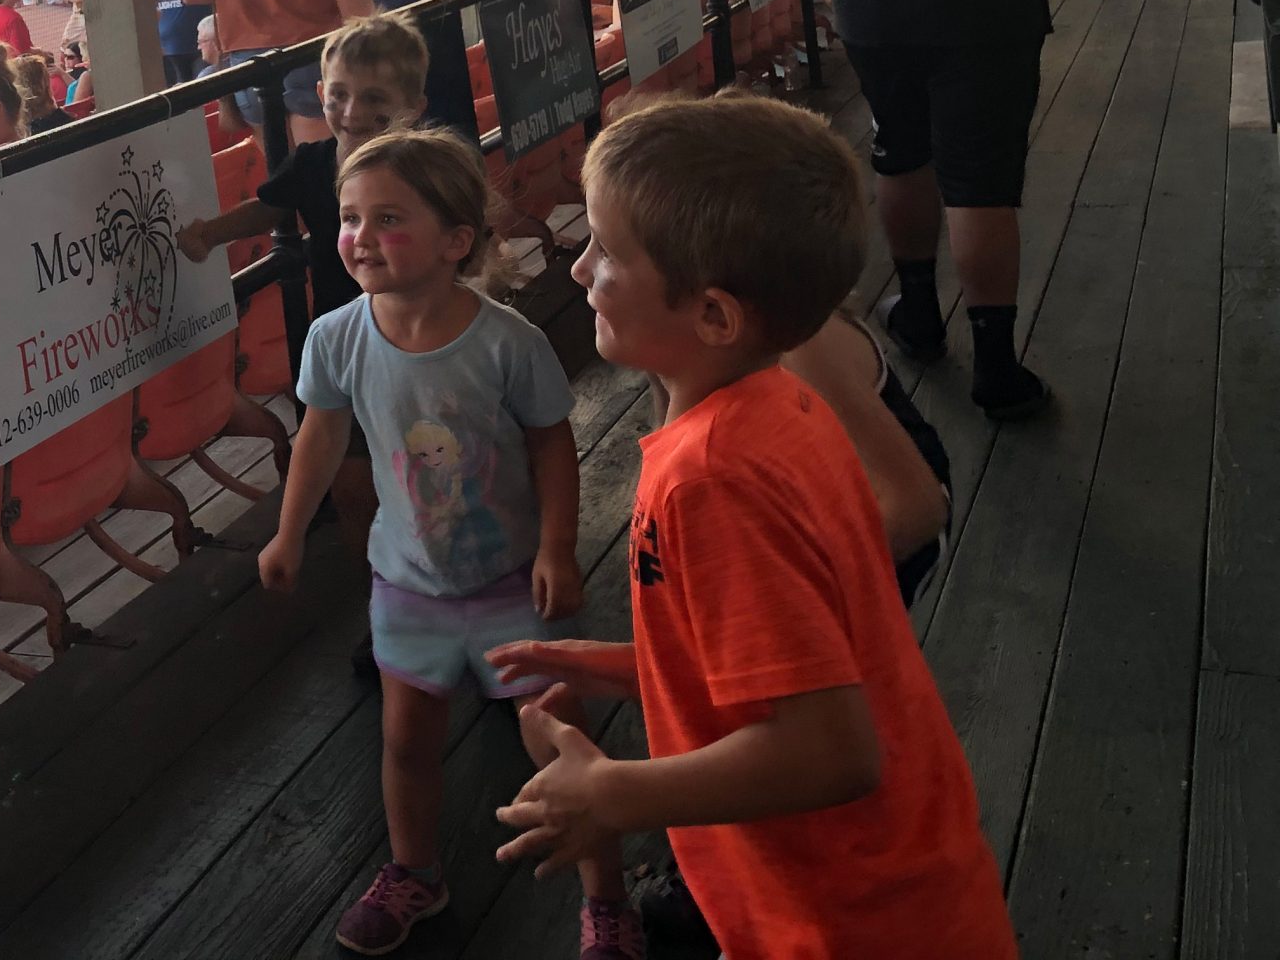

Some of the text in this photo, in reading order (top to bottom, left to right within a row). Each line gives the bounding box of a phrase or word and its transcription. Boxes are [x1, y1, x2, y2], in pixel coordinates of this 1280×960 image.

[31, 221, 123, 293] Meyer
[17, 288, 162, 396] Fireworks
[90, 300, 232, 394] meyerfireworks@live.com
